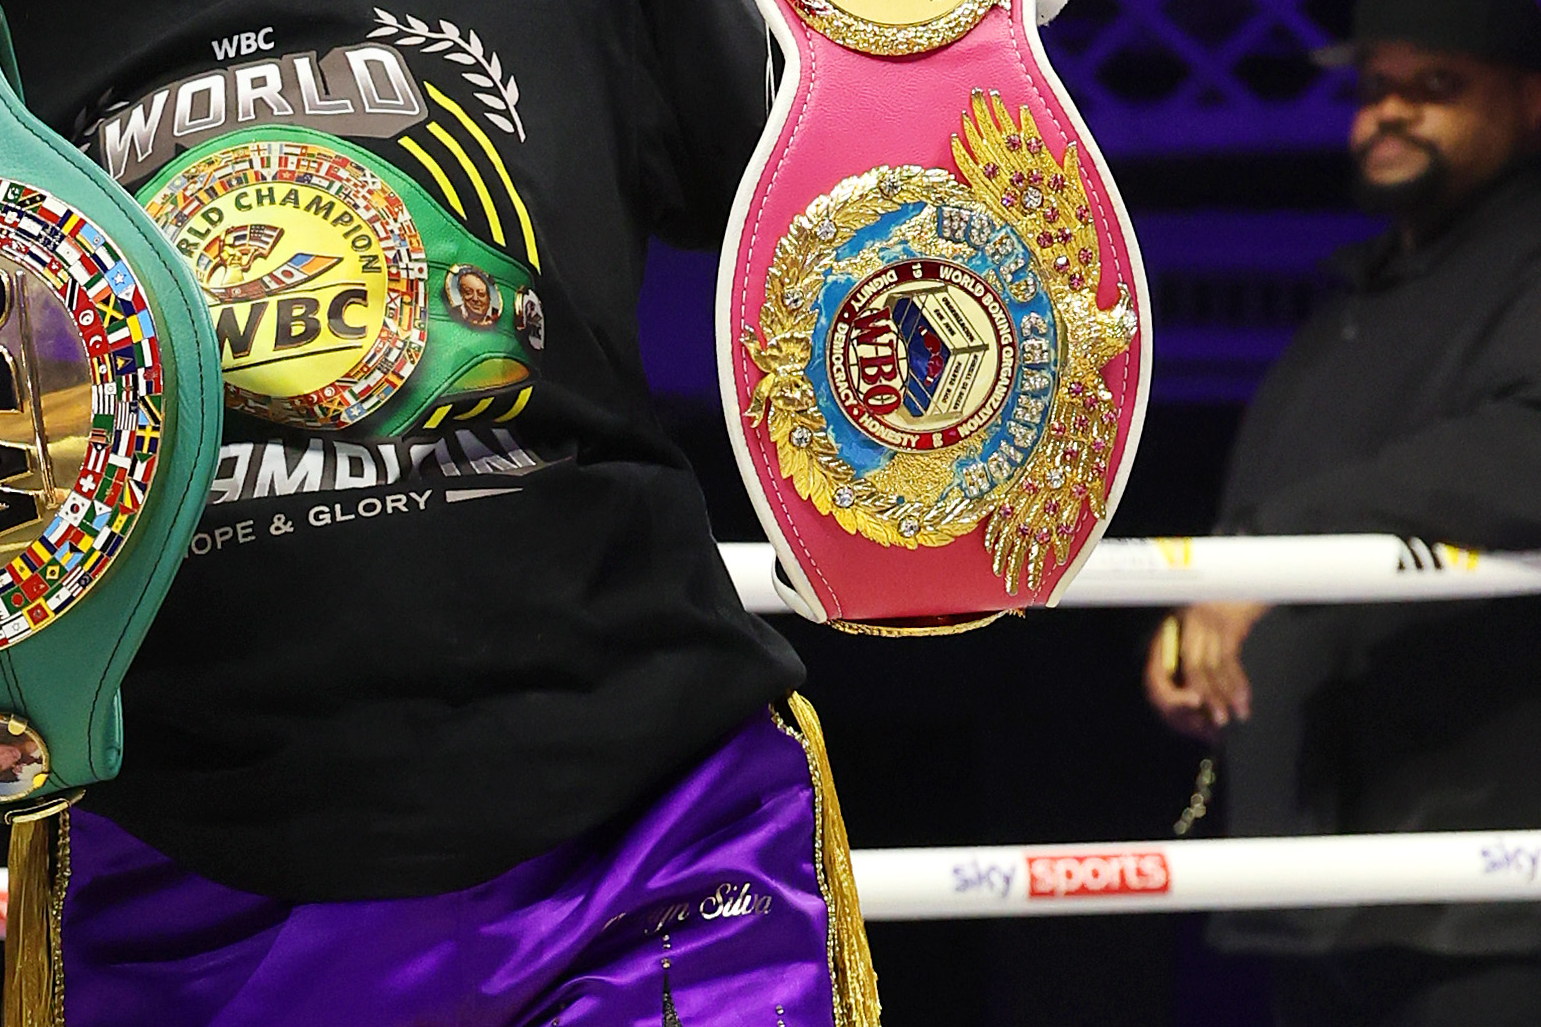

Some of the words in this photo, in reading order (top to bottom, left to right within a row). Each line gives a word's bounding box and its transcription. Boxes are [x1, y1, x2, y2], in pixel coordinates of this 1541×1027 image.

[211, 26, 275, 61] WBC
[104, 46, 420, 181] WORLD
[176, 206, 224, 259] RLD
[234, 186, 382, 274] CHAMPION
[851, 269, 898, 311] DIGNITY
[940, 266, 985, 297] WORLD
[217, 288, 368, 359] WBC
[981, 293, 1013, 344] BOXING
[832, 322, 857, 407] DEMOCRACY
[852, 306, 901, 415] WBO
[958, 346, 1014, 438] ORGANIZATION
[859, 415, 919, 448] HONESTY
[184, 519, 256, 559] OPE
[269, 513, 295, 536] &
[308, 489, 434, 527] GLORY
[699, 882, 772, 920] Silva
[953, 858, 1016, 899] sky
[1031, 854, 1170, 895] sports
